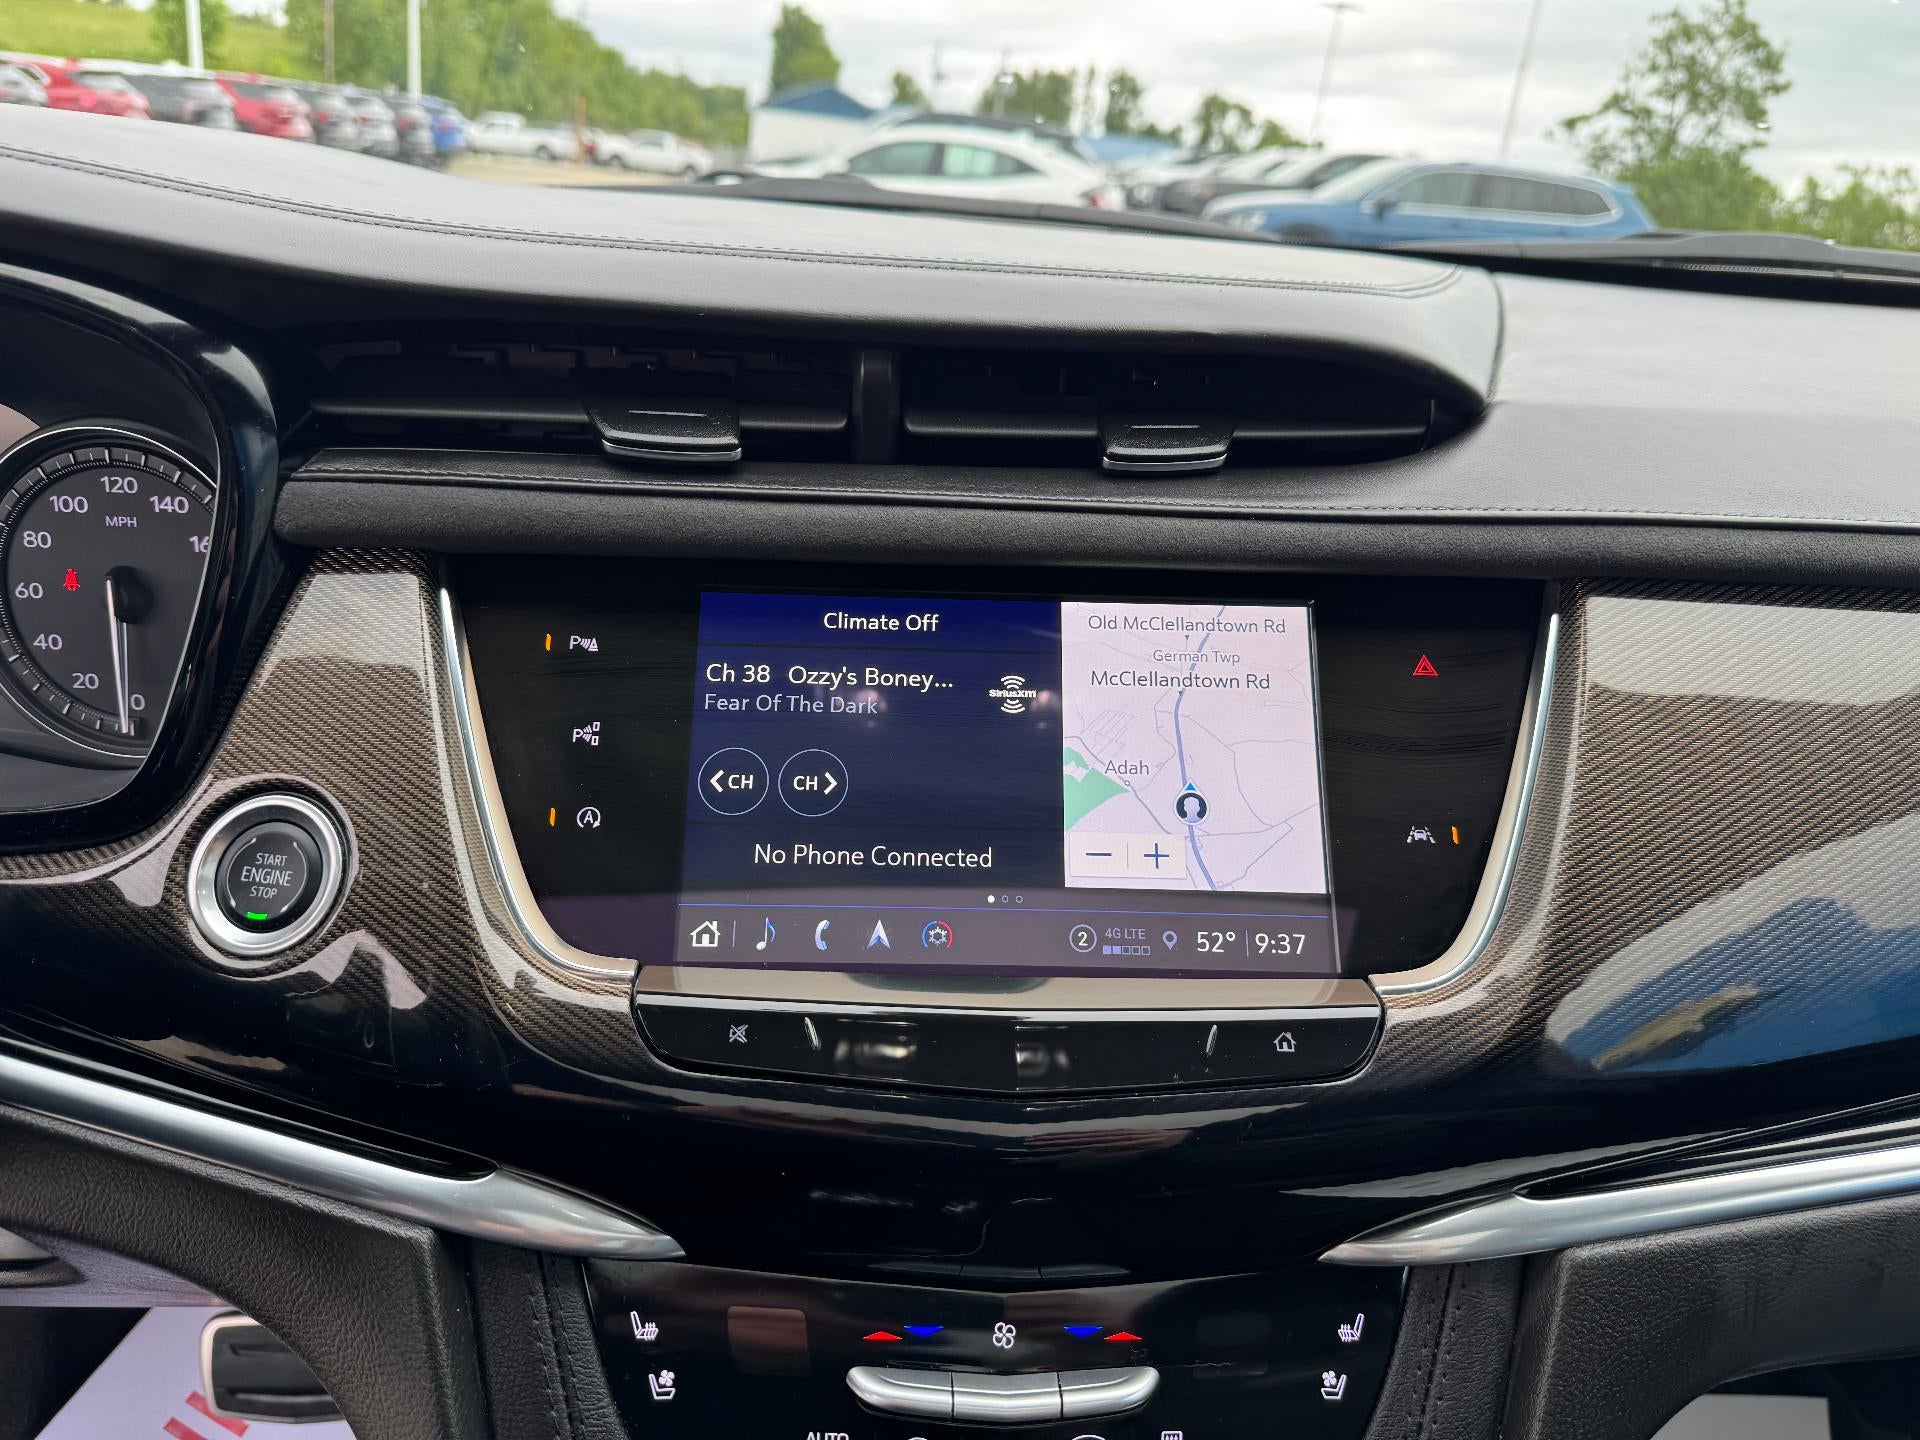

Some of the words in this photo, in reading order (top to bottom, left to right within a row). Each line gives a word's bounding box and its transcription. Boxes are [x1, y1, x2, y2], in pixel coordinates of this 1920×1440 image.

[100, 476, 138, 494] 120
[50, 496, 88, 513] 100
[150, 495, 189, 513] 140
[105, 516, 138, 528] MPH
[23, 531, 52, 549] 80
[15, 582, 44, 599] 60
[823, 612, 900, 630] Climate
[905, 614, 940, 632] Off
[1088, 615, 1118, 631] Old
[1123, 616, 1258, 633] McClellandtown
[1264, 619, 1287, 634] Rd
[33, 634, 63, 651] 40
[1152, 649, 1208, 663] German
[1211, 651, 1241, 667] Twp
[71, 673, 100, 689] 20
[706, 663, 736, 683] Ch
[742, 664, 771, 683] 38
[788, 665, 858, 691] Ozzy's
[1091, 671, 1240, 690] McClellandtown
[1246, 674, 1271, 690] Rd
[131, 694, 145, 710] 0
[704, 693, 750, 712] Fear
[755, 694, 783, 713] Of
[786, 695, 824, 713] The
[830, 696, 878, 715] Dark
[1104, 760, 1150, 776] Adah
[727, 774, 754, 790] CH
[793, 775, 818, 791] CH
[256, 853, 287, 866] START
[754, 844, 787, 865] No
[793, 845, 864, 866] Phone
[871, 846, 993, 868] Connected
[241, 866, 293, 886] ENGINE
[249, 886, 277, 898] STOP
[1077, 931, 1089, 947] 2
[1104, 927, 1121, 939] 4G
[1124, 928, 1146, 940] LTE
[1254, 932, 1306, 955] 9:37
